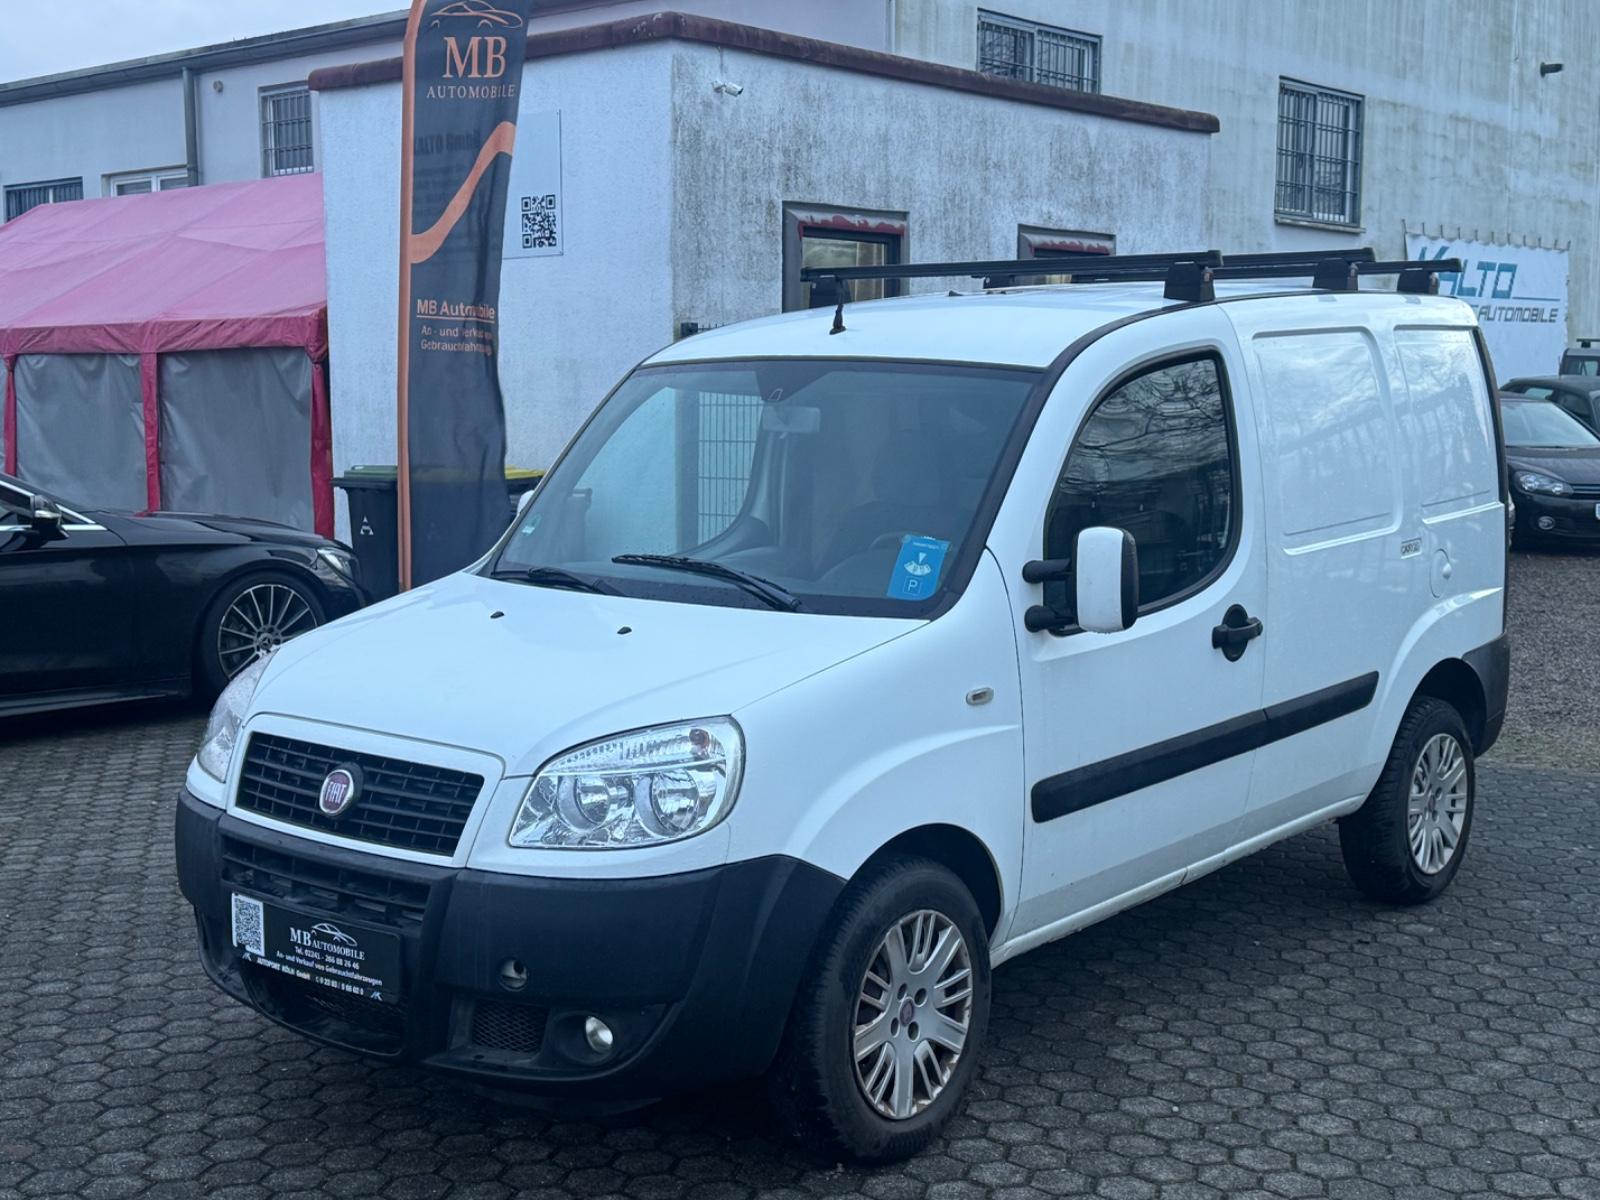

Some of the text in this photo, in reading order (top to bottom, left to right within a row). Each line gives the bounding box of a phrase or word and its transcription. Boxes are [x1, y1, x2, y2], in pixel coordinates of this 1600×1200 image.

[442, 36, 507, 79] MB
[426, 85, 515, 99] AUTOMOBILE
[1417, 245, 1518, 299] ALTO
[417, 299, 438, 315] MB
[439, 327, 459, 337] und
[907, 579, 918, 592] P
[326, 781, 347, 804] FIAT
[290, 927, 366, 960] MB AUTOMOBILE
